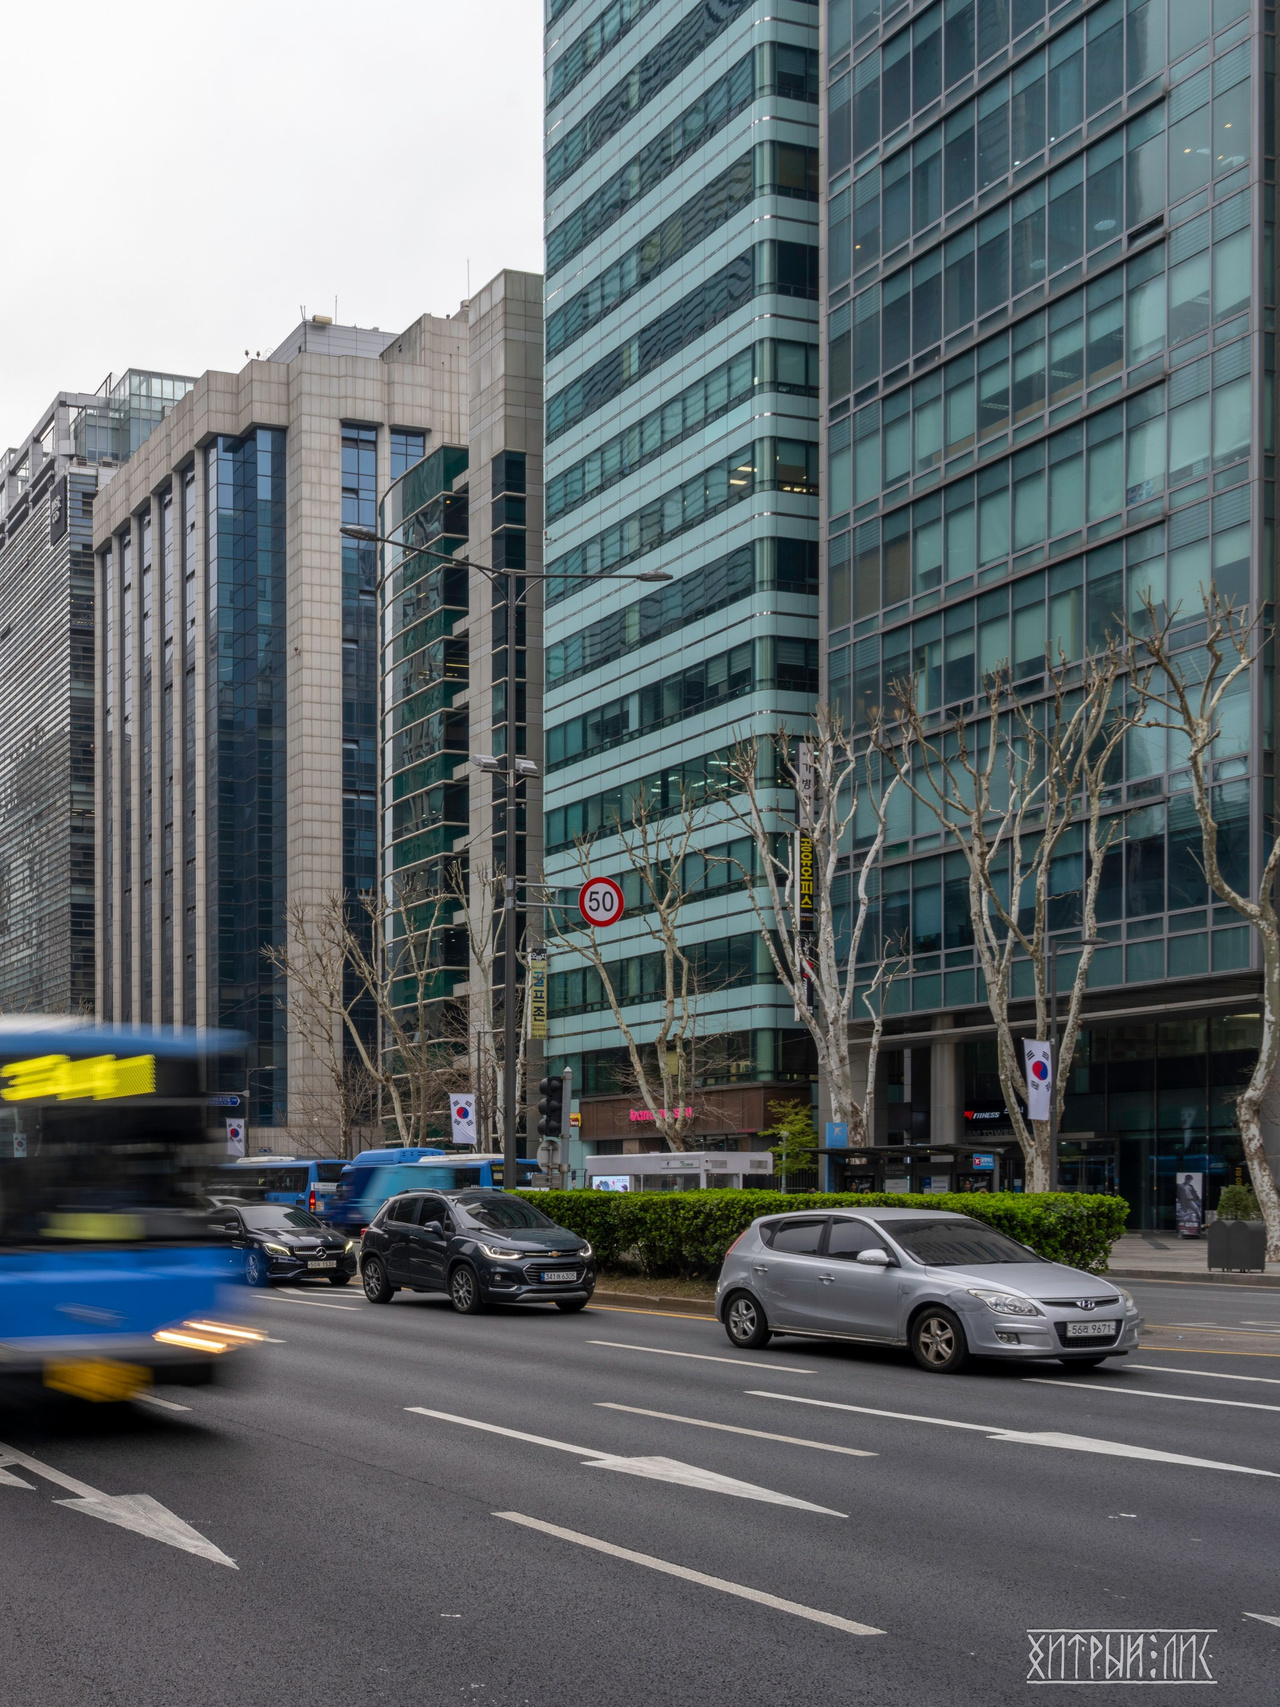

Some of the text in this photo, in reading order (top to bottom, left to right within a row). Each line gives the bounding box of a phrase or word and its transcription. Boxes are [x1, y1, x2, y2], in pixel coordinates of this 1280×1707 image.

[801, 837, 813, 908] 공유오피스
[589, 891, 614, 912] 50
[1091, 1323, 1112, 1334] 9671
